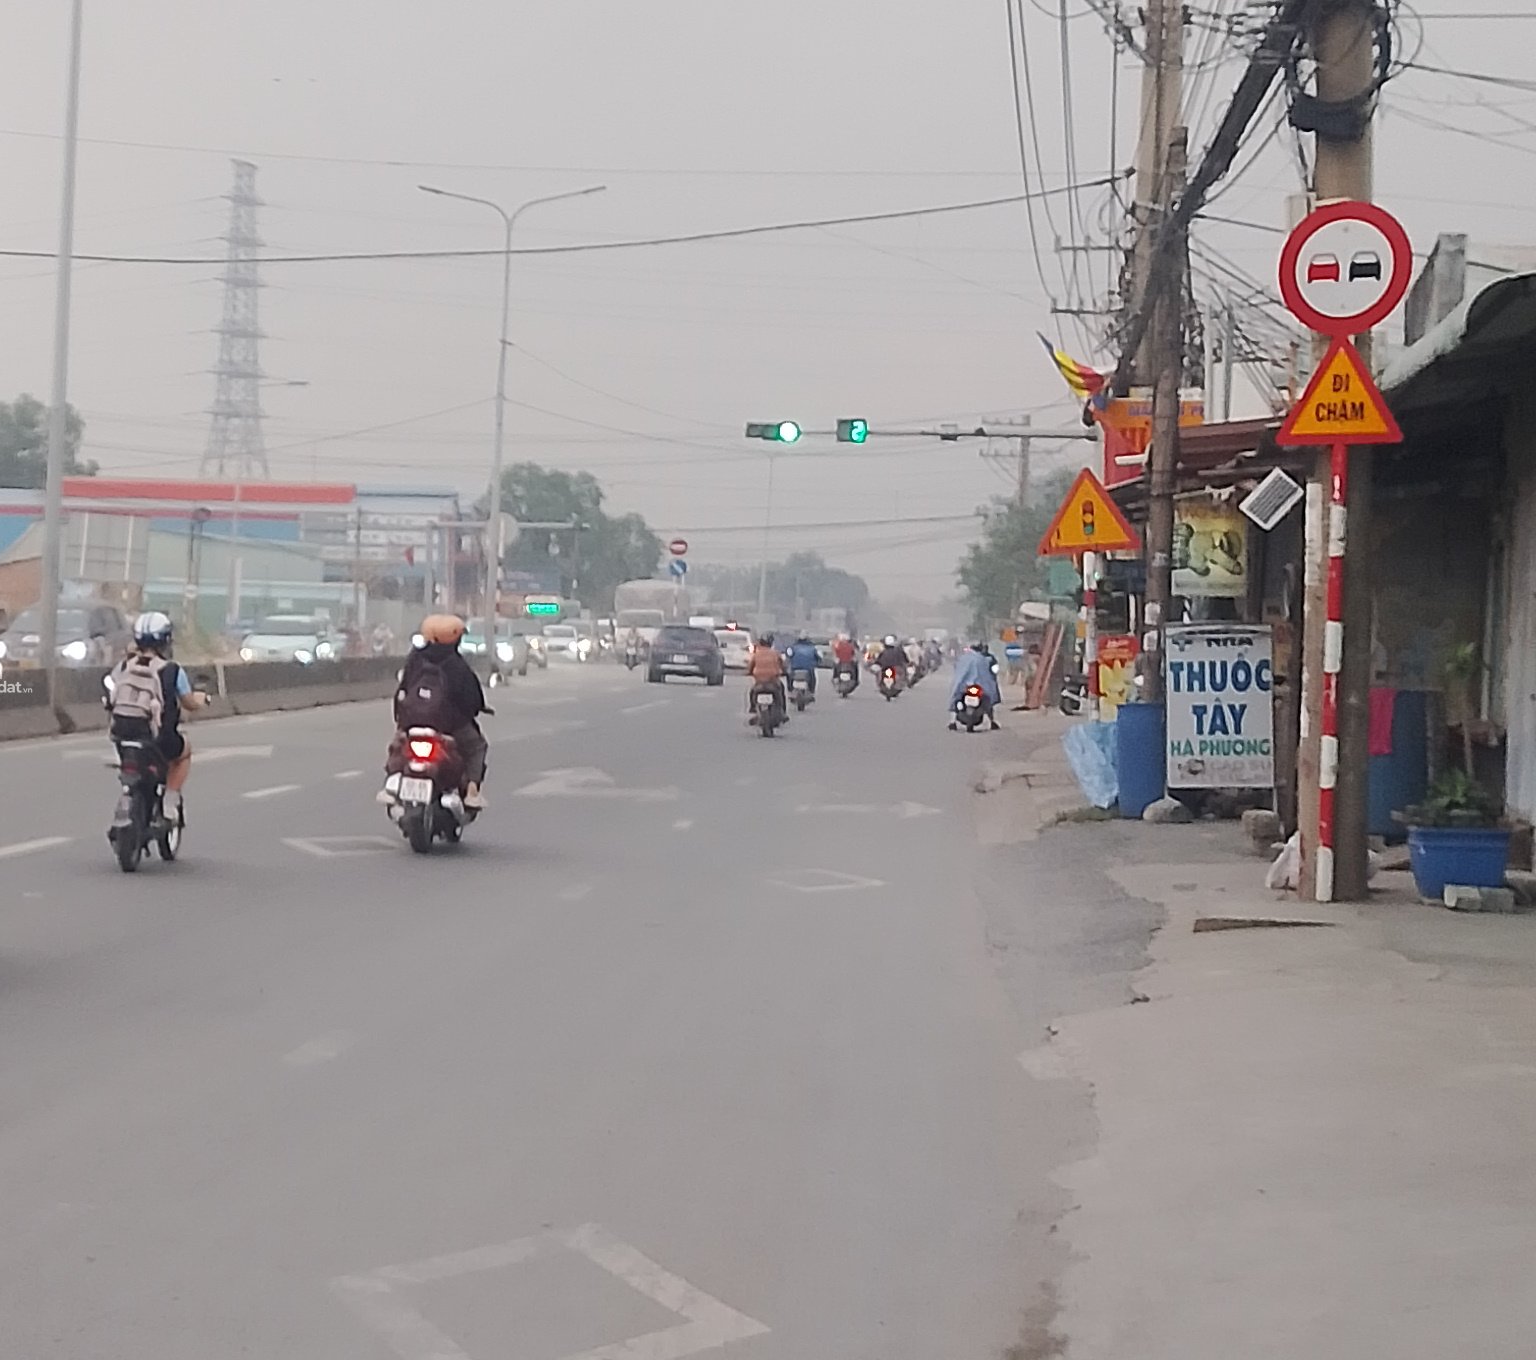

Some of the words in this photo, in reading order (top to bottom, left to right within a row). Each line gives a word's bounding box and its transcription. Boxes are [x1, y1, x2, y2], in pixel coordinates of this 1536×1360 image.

[1315, 400, 1365, 423] CHẬM
[1170, 648, 1271, 692] THUỐC
[1192, 697, 1248, 736] TÂY
